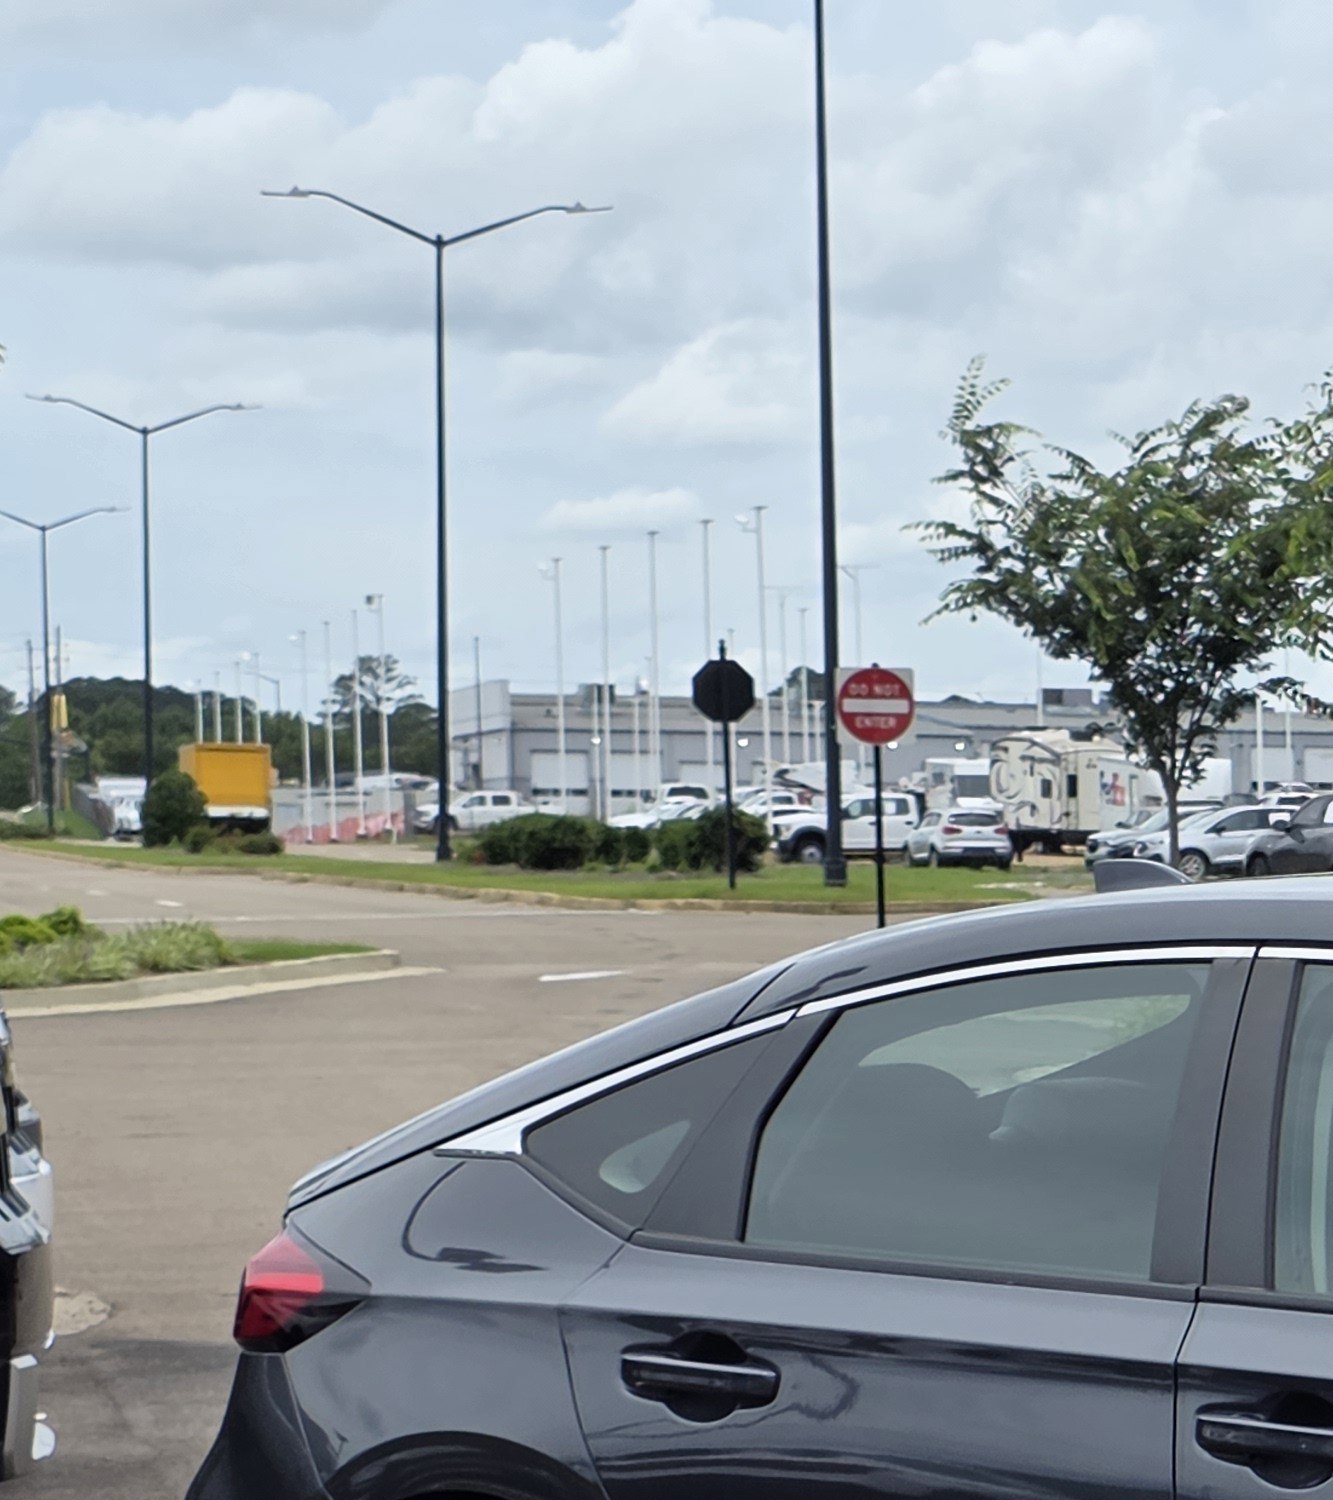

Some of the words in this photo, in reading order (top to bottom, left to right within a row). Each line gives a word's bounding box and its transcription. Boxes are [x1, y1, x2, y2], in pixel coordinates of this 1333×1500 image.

[848, 683, 869, 696] DO
[873, 683, 901, 696] NOT
[855, 716, 898, 729] ENTER
